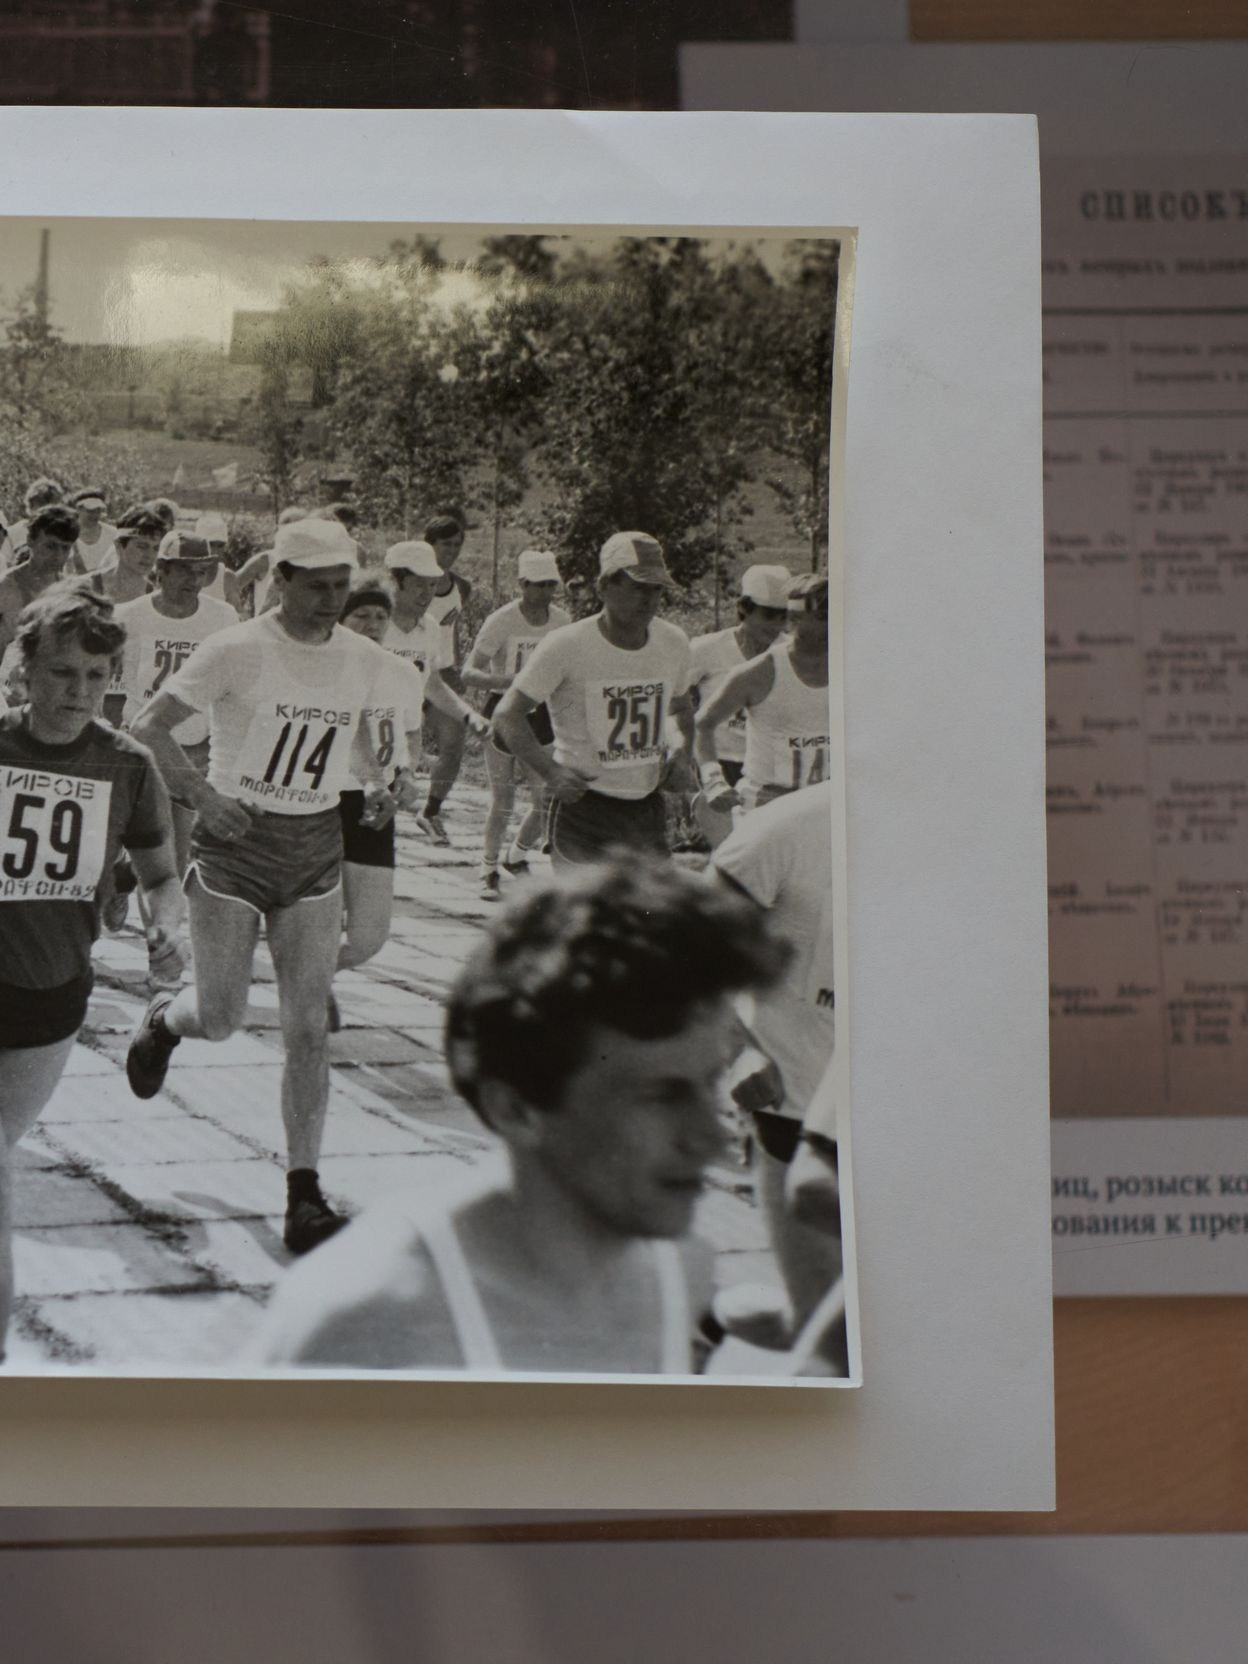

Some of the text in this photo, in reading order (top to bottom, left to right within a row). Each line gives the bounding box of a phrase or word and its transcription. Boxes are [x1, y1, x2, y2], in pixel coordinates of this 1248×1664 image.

[602, 682, 664, 698] КИРОВ
[276, 703, 352, 726] КИРОВ
[608, 695, 663, 751] 251
[262, 721, 338, 790] 114
[1105, 1174, 1212, 1203] розыск
[1052, 1214, 1156, 1236] ования
[1165, 1214, 1182, 1235] к
